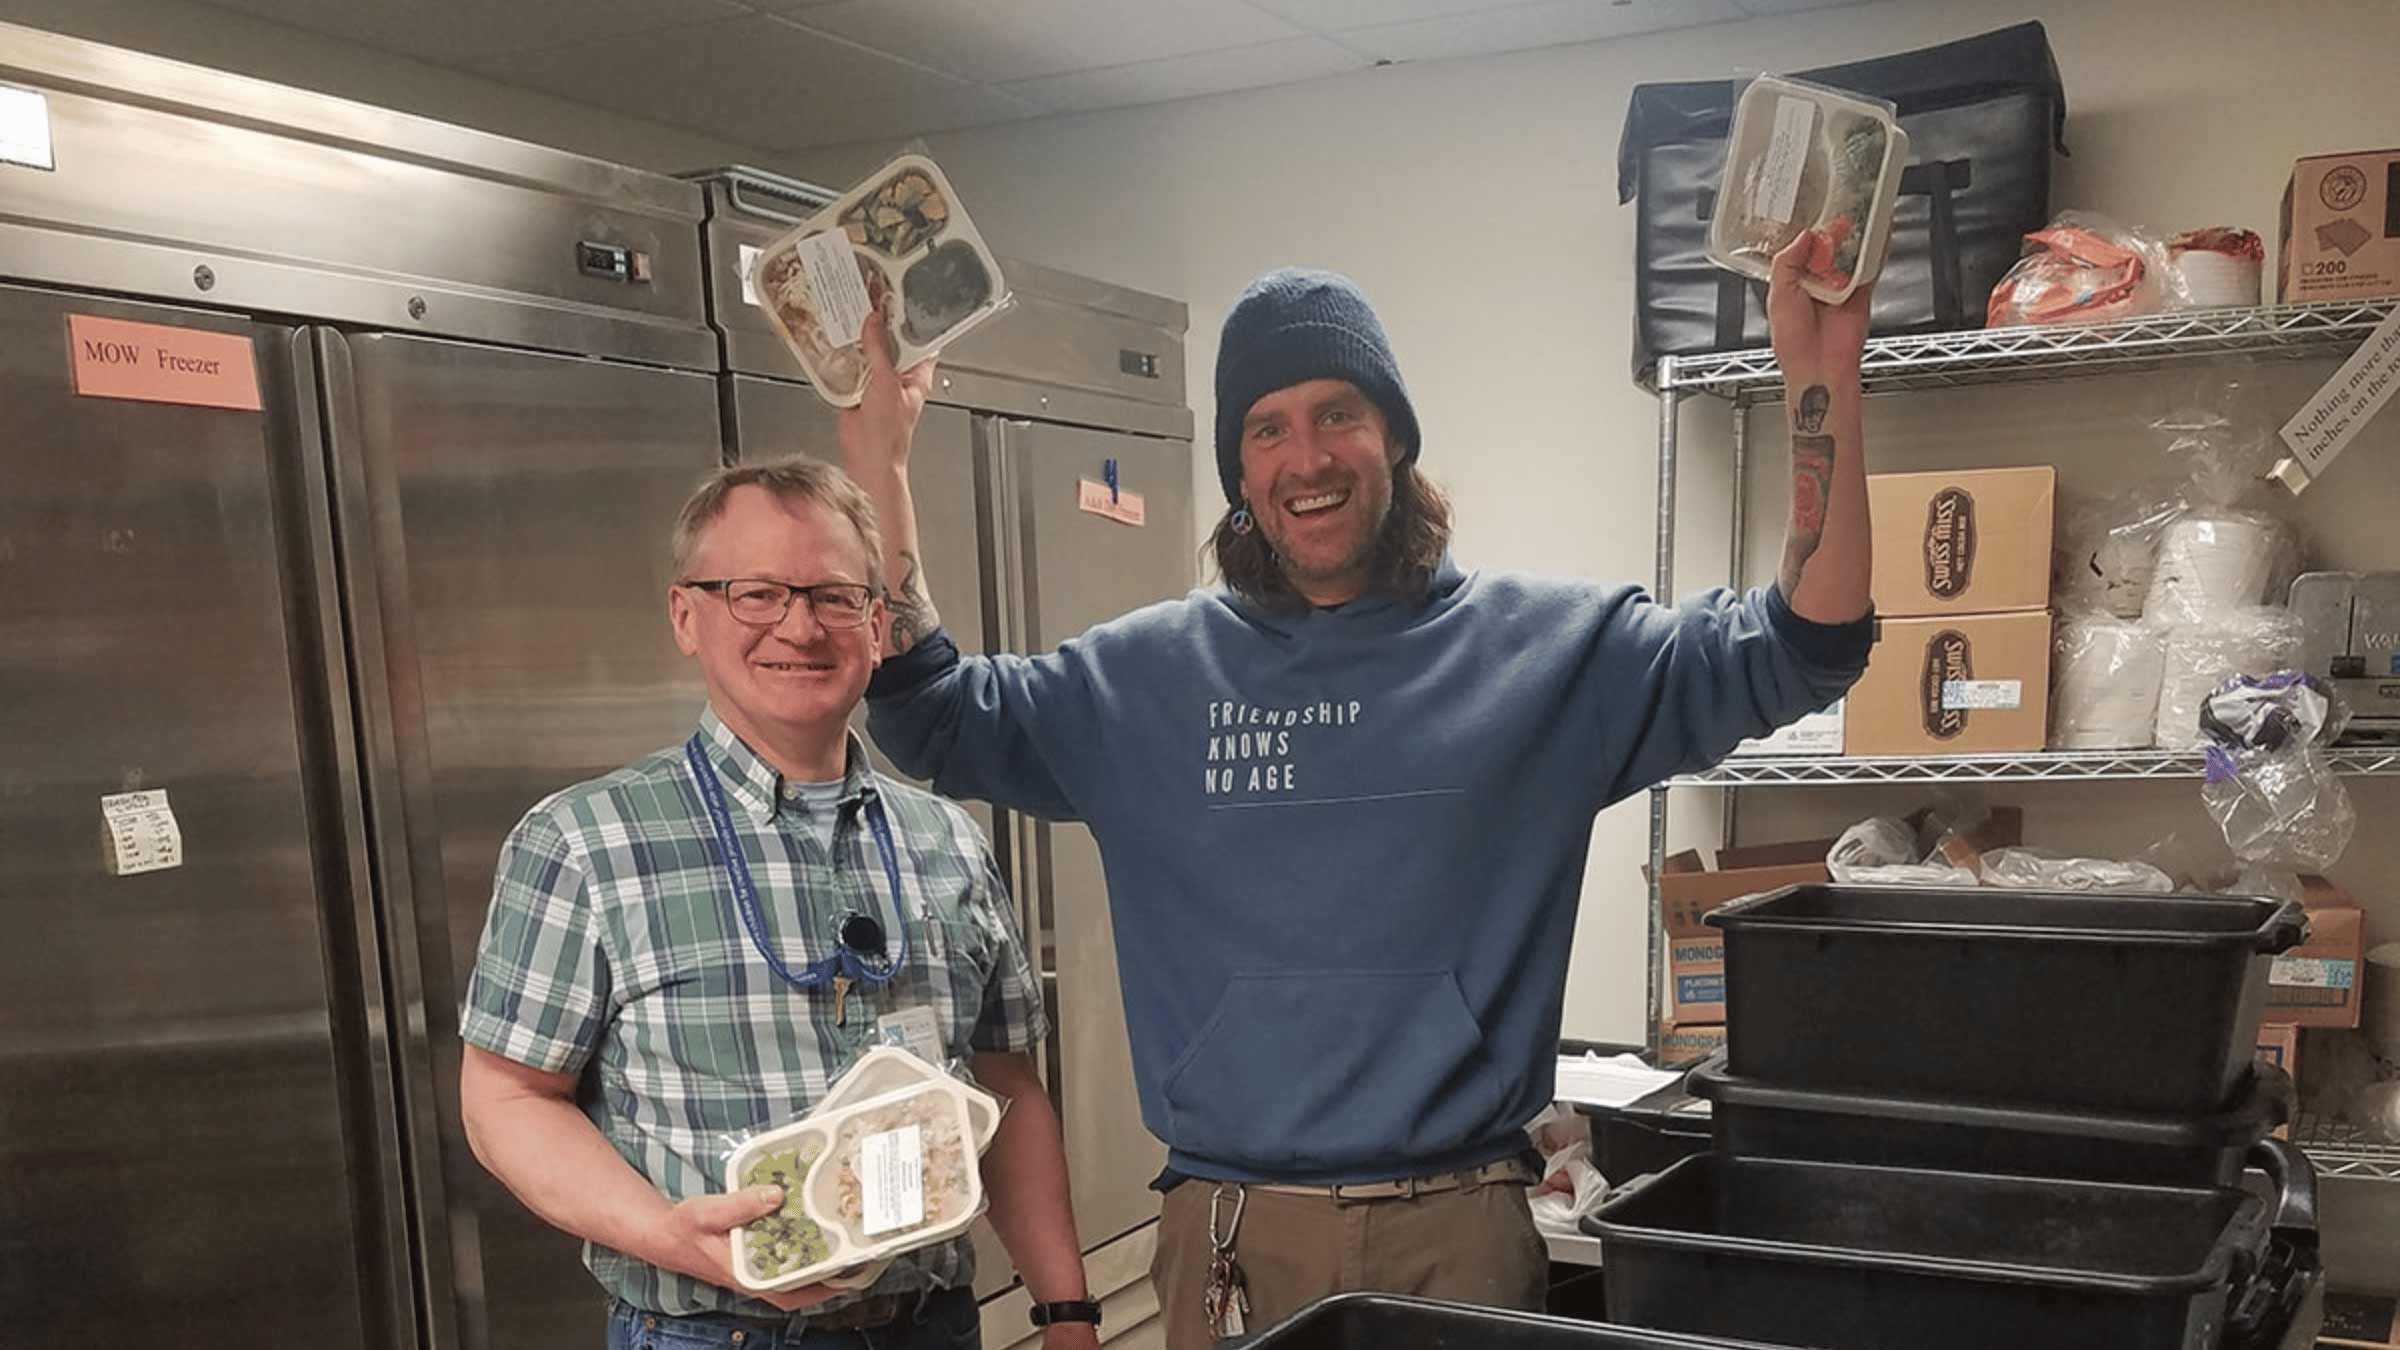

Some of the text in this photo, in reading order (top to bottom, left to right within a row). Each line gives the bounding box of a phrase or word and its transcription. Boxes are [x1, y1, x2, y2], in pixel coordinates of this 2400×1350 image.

[2316, 260, 2347, 275] 200
[84, 340, 221, 375] MOW Freezer
[2294, 387, 2351, 443] Nothing
[2349, 351, 2382, 388] more
[2308, 415, 2351, 461] inches
[2350, 395, 2369, 416] on
[2366, 372, 2390, 397] the
[1932, 542, 1952, 590] SWISS
[1209, 701, 1361, 728] FRIENDSHIP
[1208, 731, 1290, 761] KNOWS
[1205, 764, 1295, 793] NO AGE
[1675, 945, 1725, 961] MONOG
